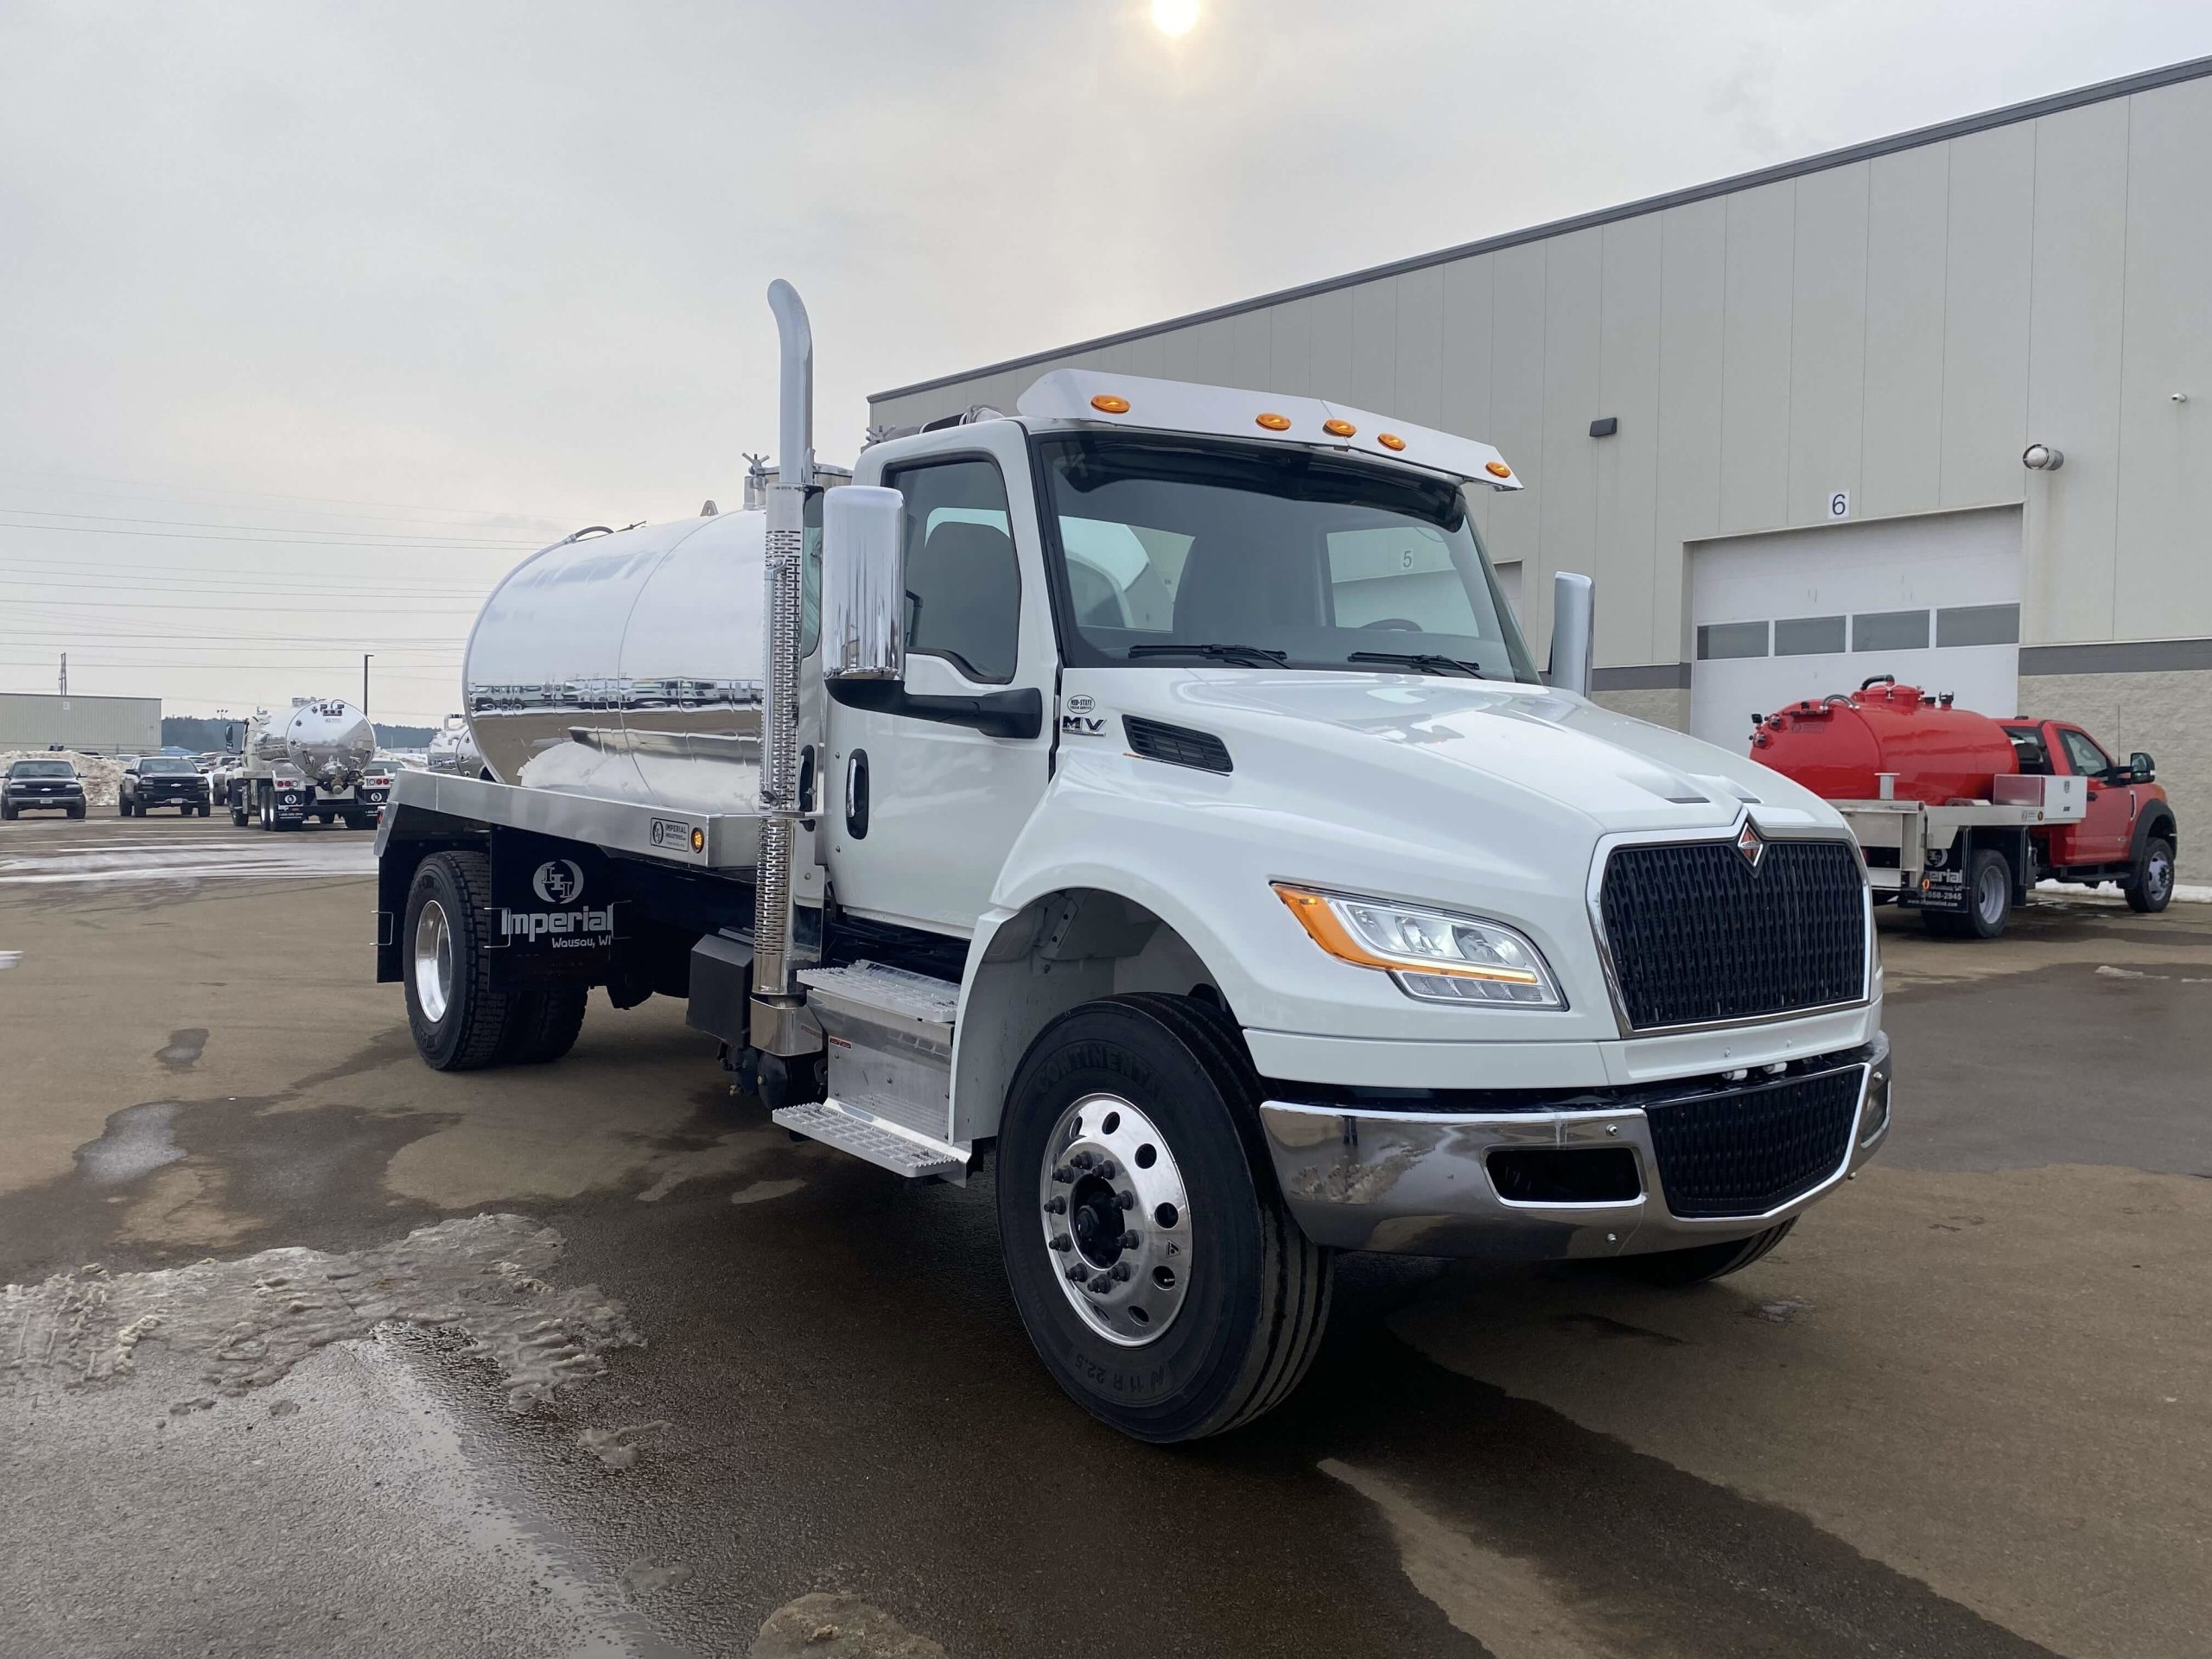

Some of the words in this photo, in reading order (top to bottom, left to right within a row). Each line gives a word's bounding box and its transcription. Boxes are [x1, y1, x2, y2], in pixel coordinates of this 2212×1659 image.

[1832, 493, 1846, 515] 6
[1402, 550, 1413, 568] 5
[1063, 715, 1106, 732] MV
[665, 824, 686, 834] IMPERIAL
[501, 905, 613, 942] Imperial
[551, 936, 595, 949] Wausau,
[598, 935, 611, 946] WI
